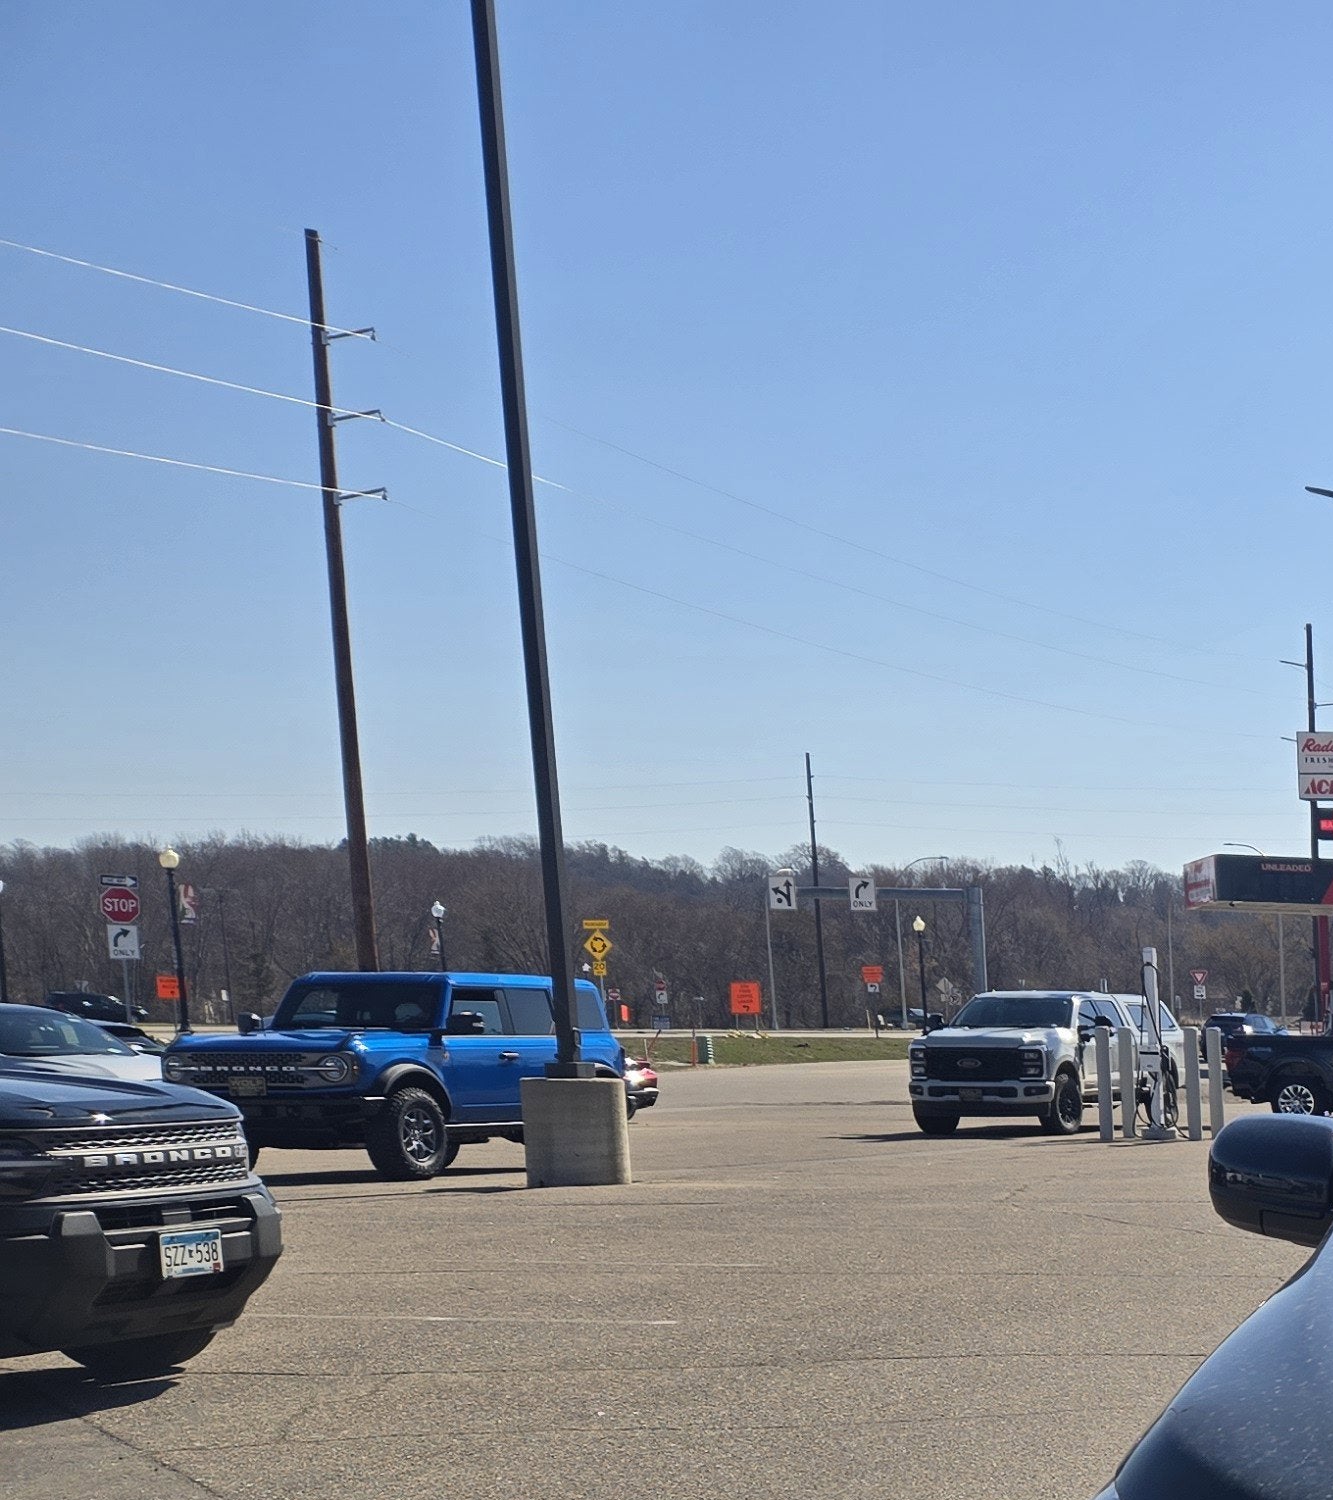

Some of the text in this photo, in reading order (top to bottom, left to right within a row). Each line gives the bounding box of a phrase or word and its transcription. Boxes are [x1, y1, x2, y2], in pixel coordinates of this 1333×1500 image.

[1260, 863, 1312, 873] UNLEADED
[104, 898, 136, 912] STOP
[853, 900, 873, 908] ONLY
[113, 949, 136, 957] ONLY
[594, 962, 605, 971] 20
[83, 1146, 232, 1168] BRONCO
